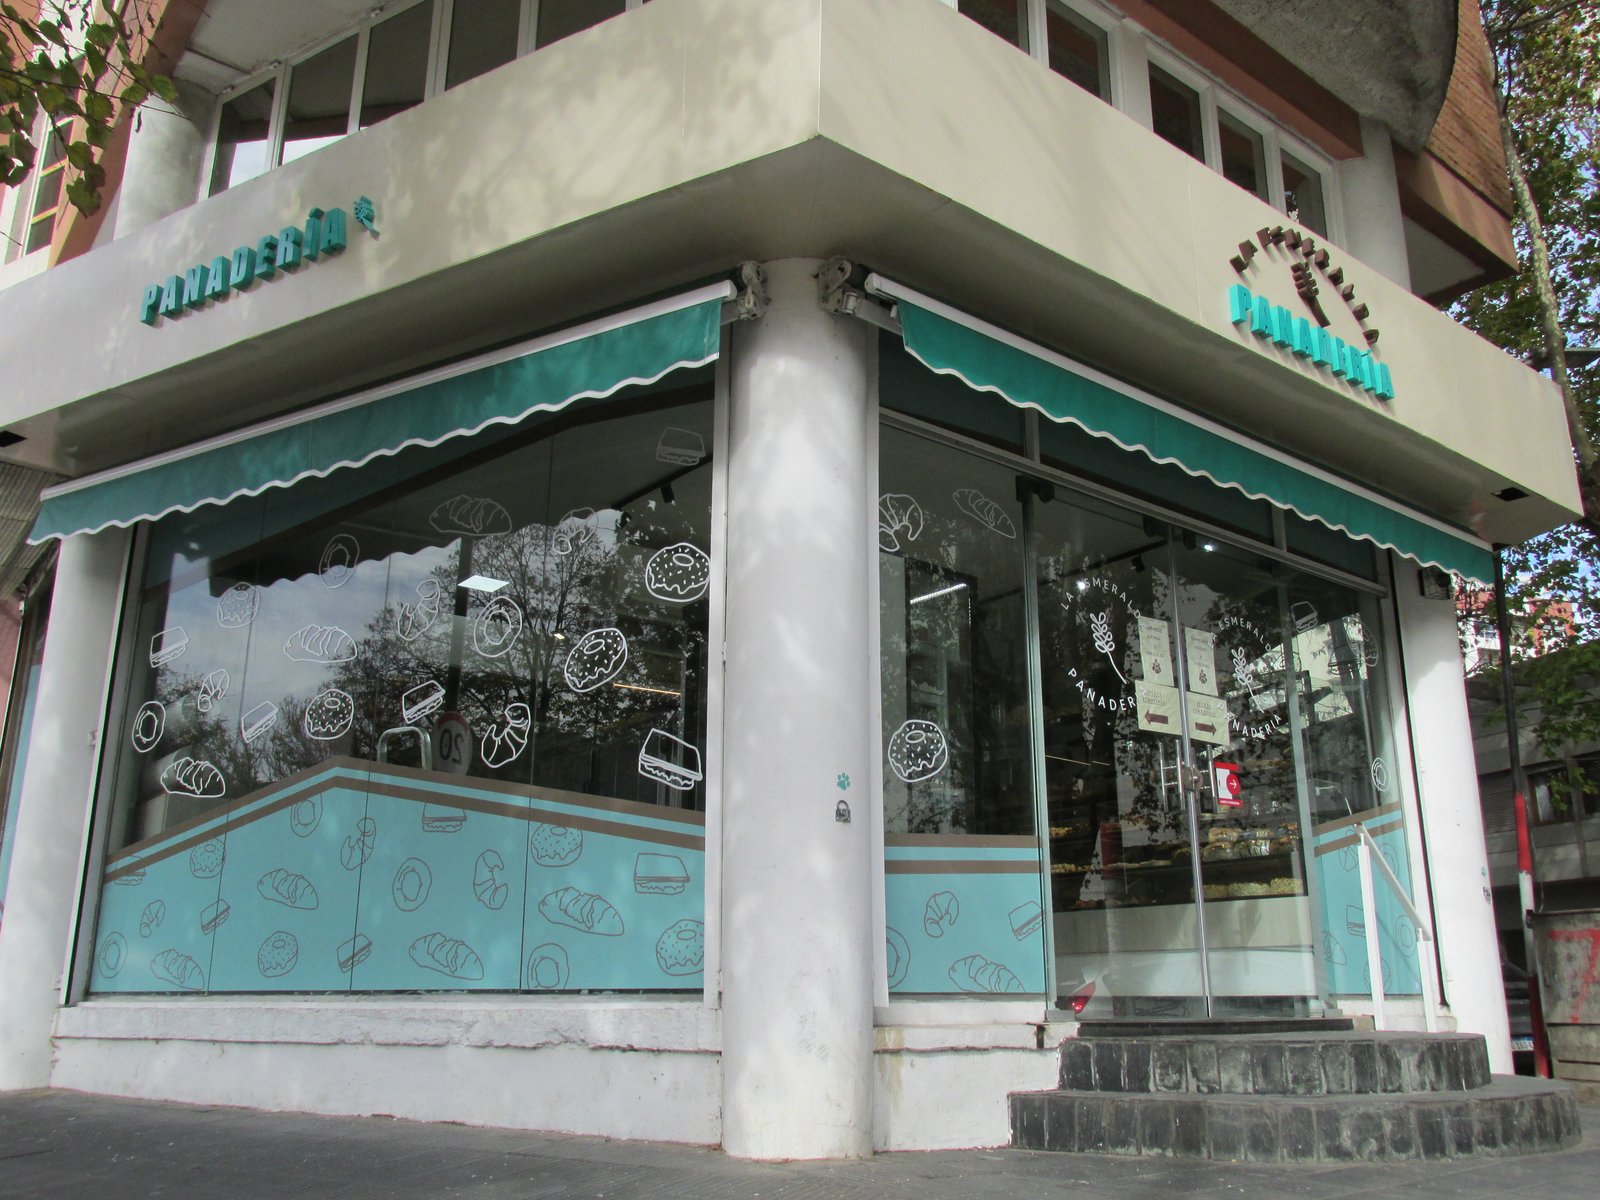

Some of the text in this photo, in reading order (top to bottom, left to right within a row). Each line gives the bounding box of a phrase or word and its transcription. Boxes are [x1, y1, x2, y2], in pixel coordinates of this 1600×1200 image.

[140, 207, 346, 326] PANADERÍA
[1060, 591, 1075, 610] LA
[1218, 617, 1272, 652] ESMERALD
